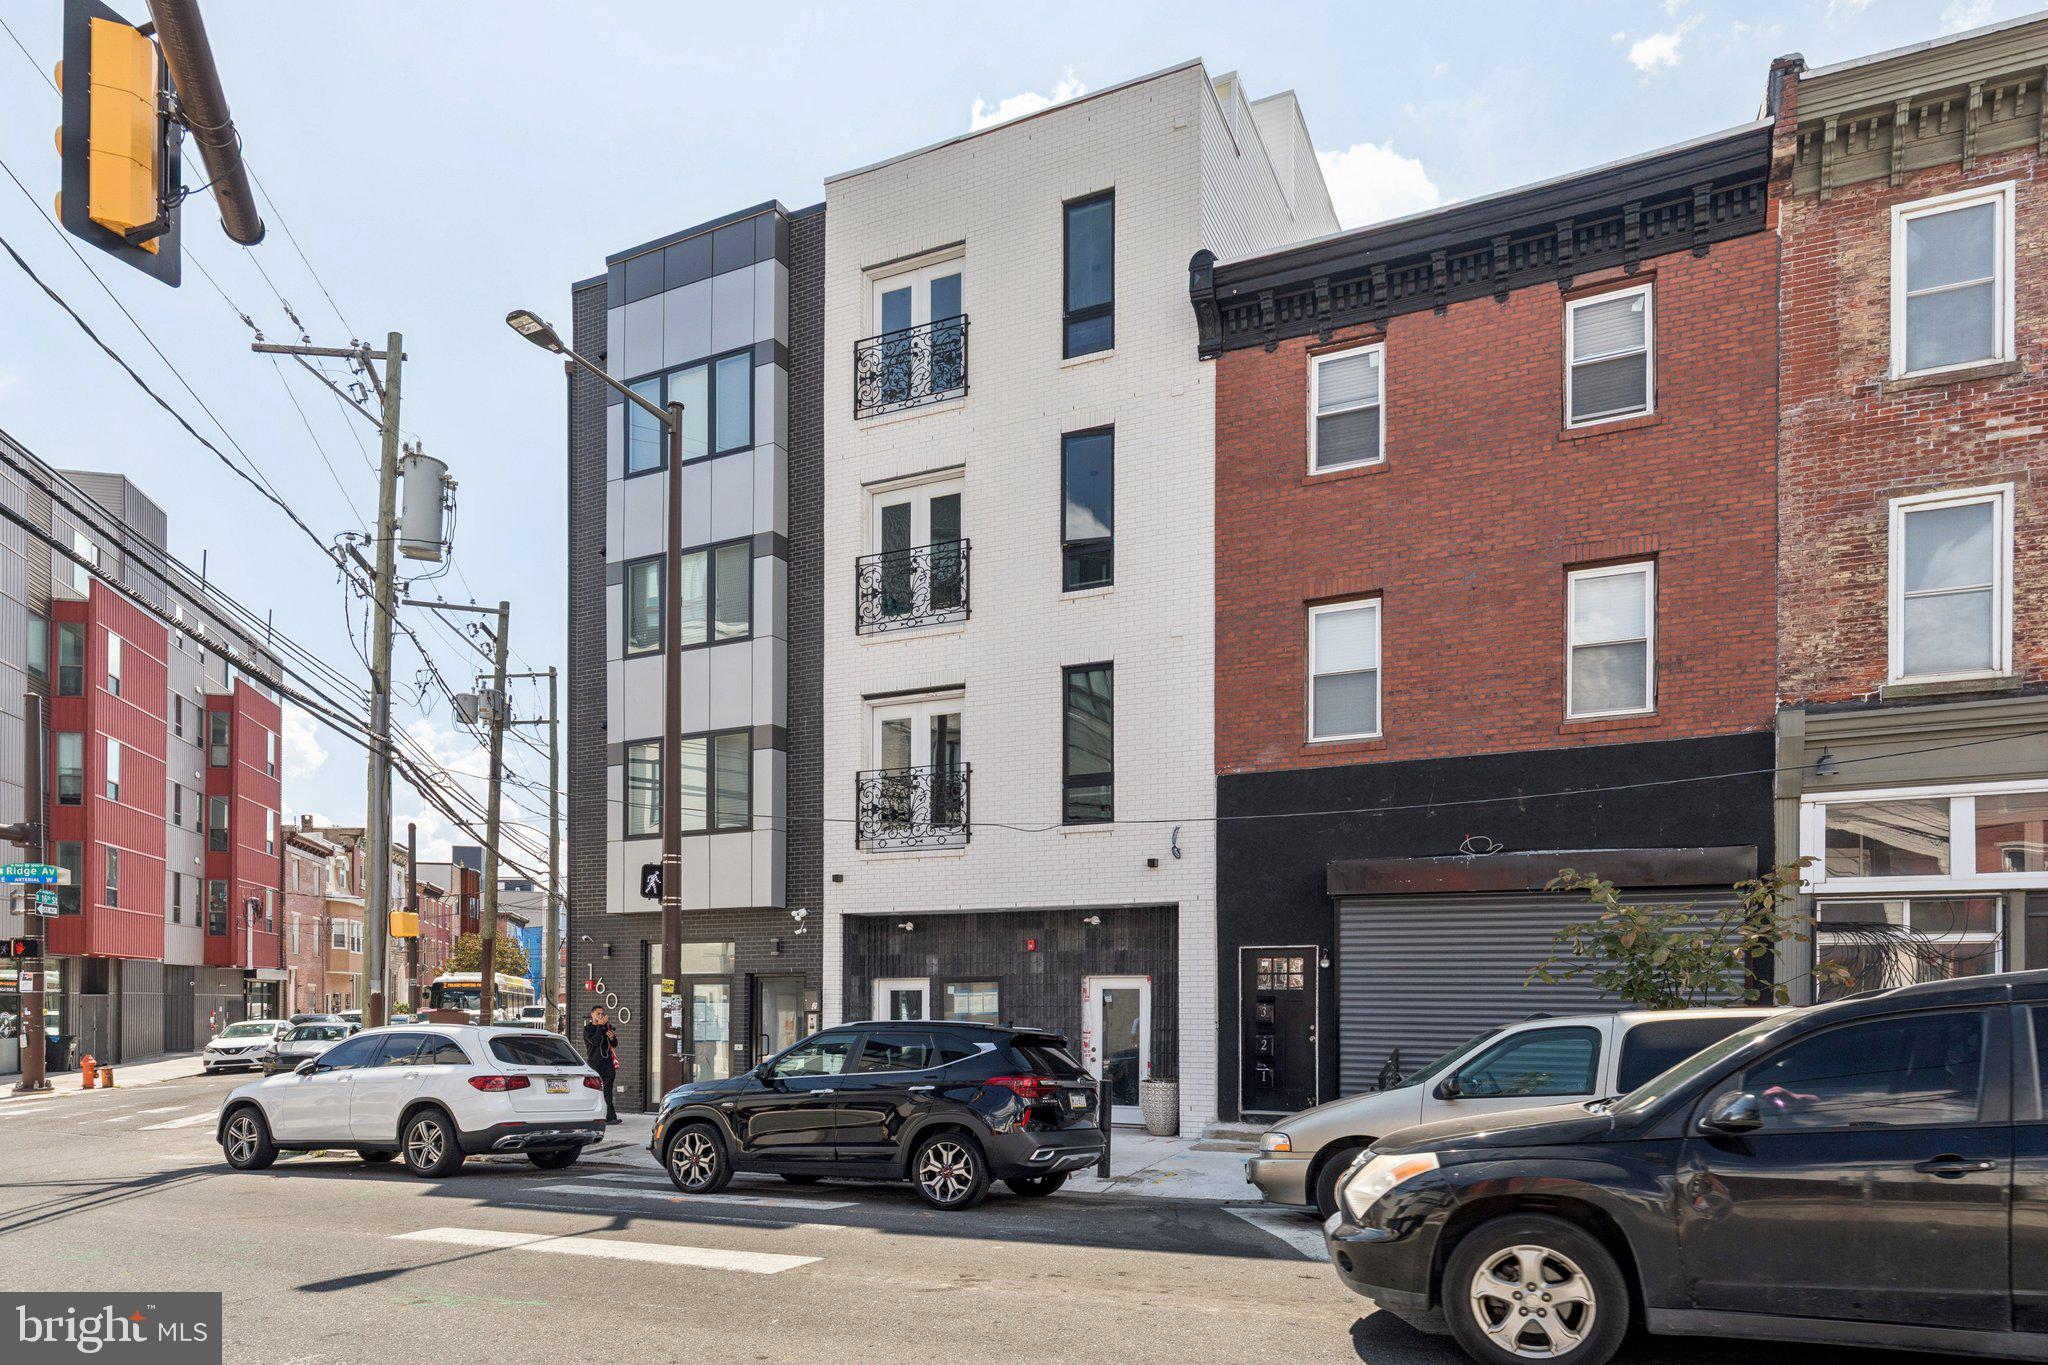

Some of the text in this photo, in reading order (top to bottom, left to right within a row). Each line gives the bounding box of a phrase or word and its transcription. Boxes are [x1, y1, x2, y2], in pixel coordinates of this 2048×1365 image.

[6, 866, 55, 877] Ridge Av
[1260, 1006, 1267, 1017] 3
[1260, 1039, 1267, 1050] 2
[1261, 1071, 1267, 1082] 1
